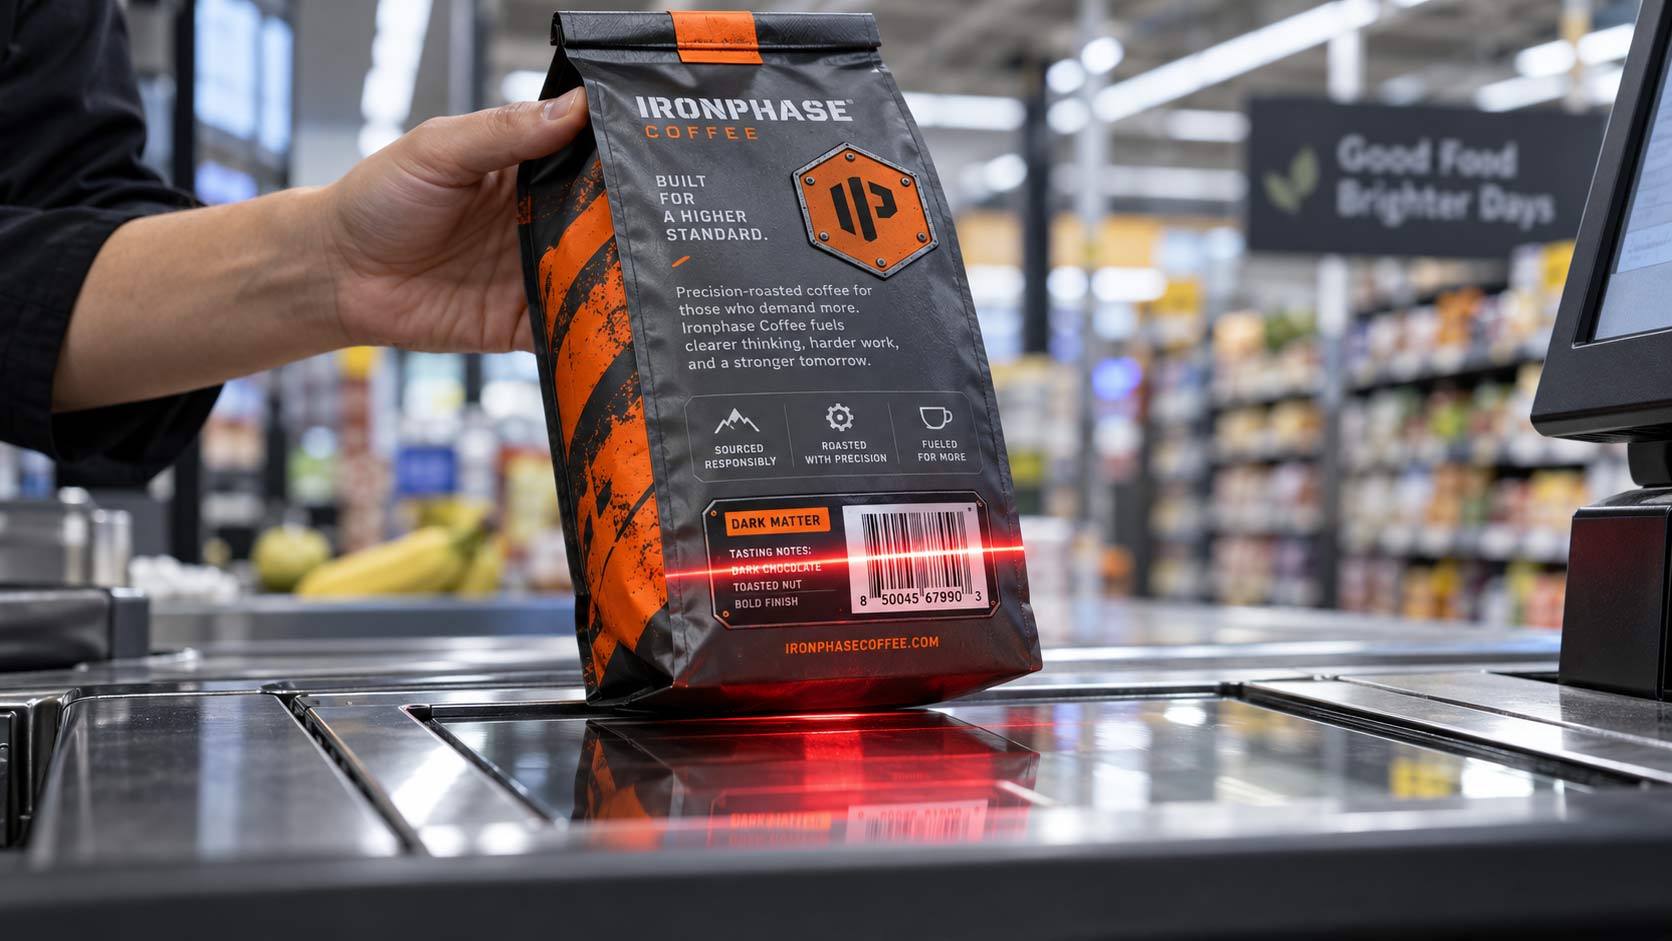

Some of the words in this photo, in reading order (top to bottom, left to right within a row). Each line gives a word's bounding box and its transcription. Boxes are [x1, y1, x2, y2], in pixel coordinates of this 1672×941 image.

[635, 96, 853, 121] IRONPHASE
[645, 125, 759, 140] COFFEE
[1336, 133, 1431, 175] Good
[1439, 139, 1518, 180] Food
[656, 175, 706, 188] BUILT
[660, 192, 694, 205] FOR
[1336, 178, 1470, 228] Brighter
[1479, 183, 1554, 231] Days
[664, 210, 675, 223] A
[681, 210, 747, 223] HIGHER
[667, 228, 768, 241] STANDARD.
[677, 286, 802, 299] Precision-roasted
[806, 285, 850, 297] coffee
[853, 285, 872, 296] for
[679, 304, 720, 316] those
[725, 303, 755, 315] who
[760, 302, 815, 314] demand
[820, 303, 859, 313] more.
[682, 320, 755, 335] Ironphase
[760, 320, 806, 331] Coffee
[810, 319, 844, 331] fuels
[686, 340, 737, 352] clearer
[741, 338, 805, 353] thinking,
[810, 337, 856, 349] harder
[860, 337, 899, 351] work,
[688, 358, 716, 370] and
[721, 361, 729, 369] a
[734, 357, 795, 371] stronger
[799, 356, 871, 367] tomorrow.
[715, 444, 764, 455] SOURCED
[822, 441, 867, 450] ROASTED
[922, 440, 957, 449] FUELED
[705, 457, 776, 469] RESPONSIBLY
[805, 455, 832, 465] WITH
[835, 453, 887, 464] PRECISION
[918, 452, 936, 462] FOR
[940, 452, 966, 461] MORE
[732, 516, 766, 530] DARK
[770, 515, 821, 527] MATTER
[729, 548, 772, 558] TASTING
[776, 546, 811, 556] NOTES:
[731, 565, 759, 575] DARK
[762, 563, 821, 573] CHOCOLATE
[733, 581, 778, 592] TOASTED
[782, 580, 802, 590] NUT
[735, 599, 761, 609] BOLD
[765, 597, 798, 607] FINISH
[860, 596, 867, 606] 8
[882, 593, 918, 605] 50045
[925, 591, 962, 603] 67990
[975, 591, 981, 601] 3
[785, 636, 939, 655] IRONPHASECOFFEE.COM
